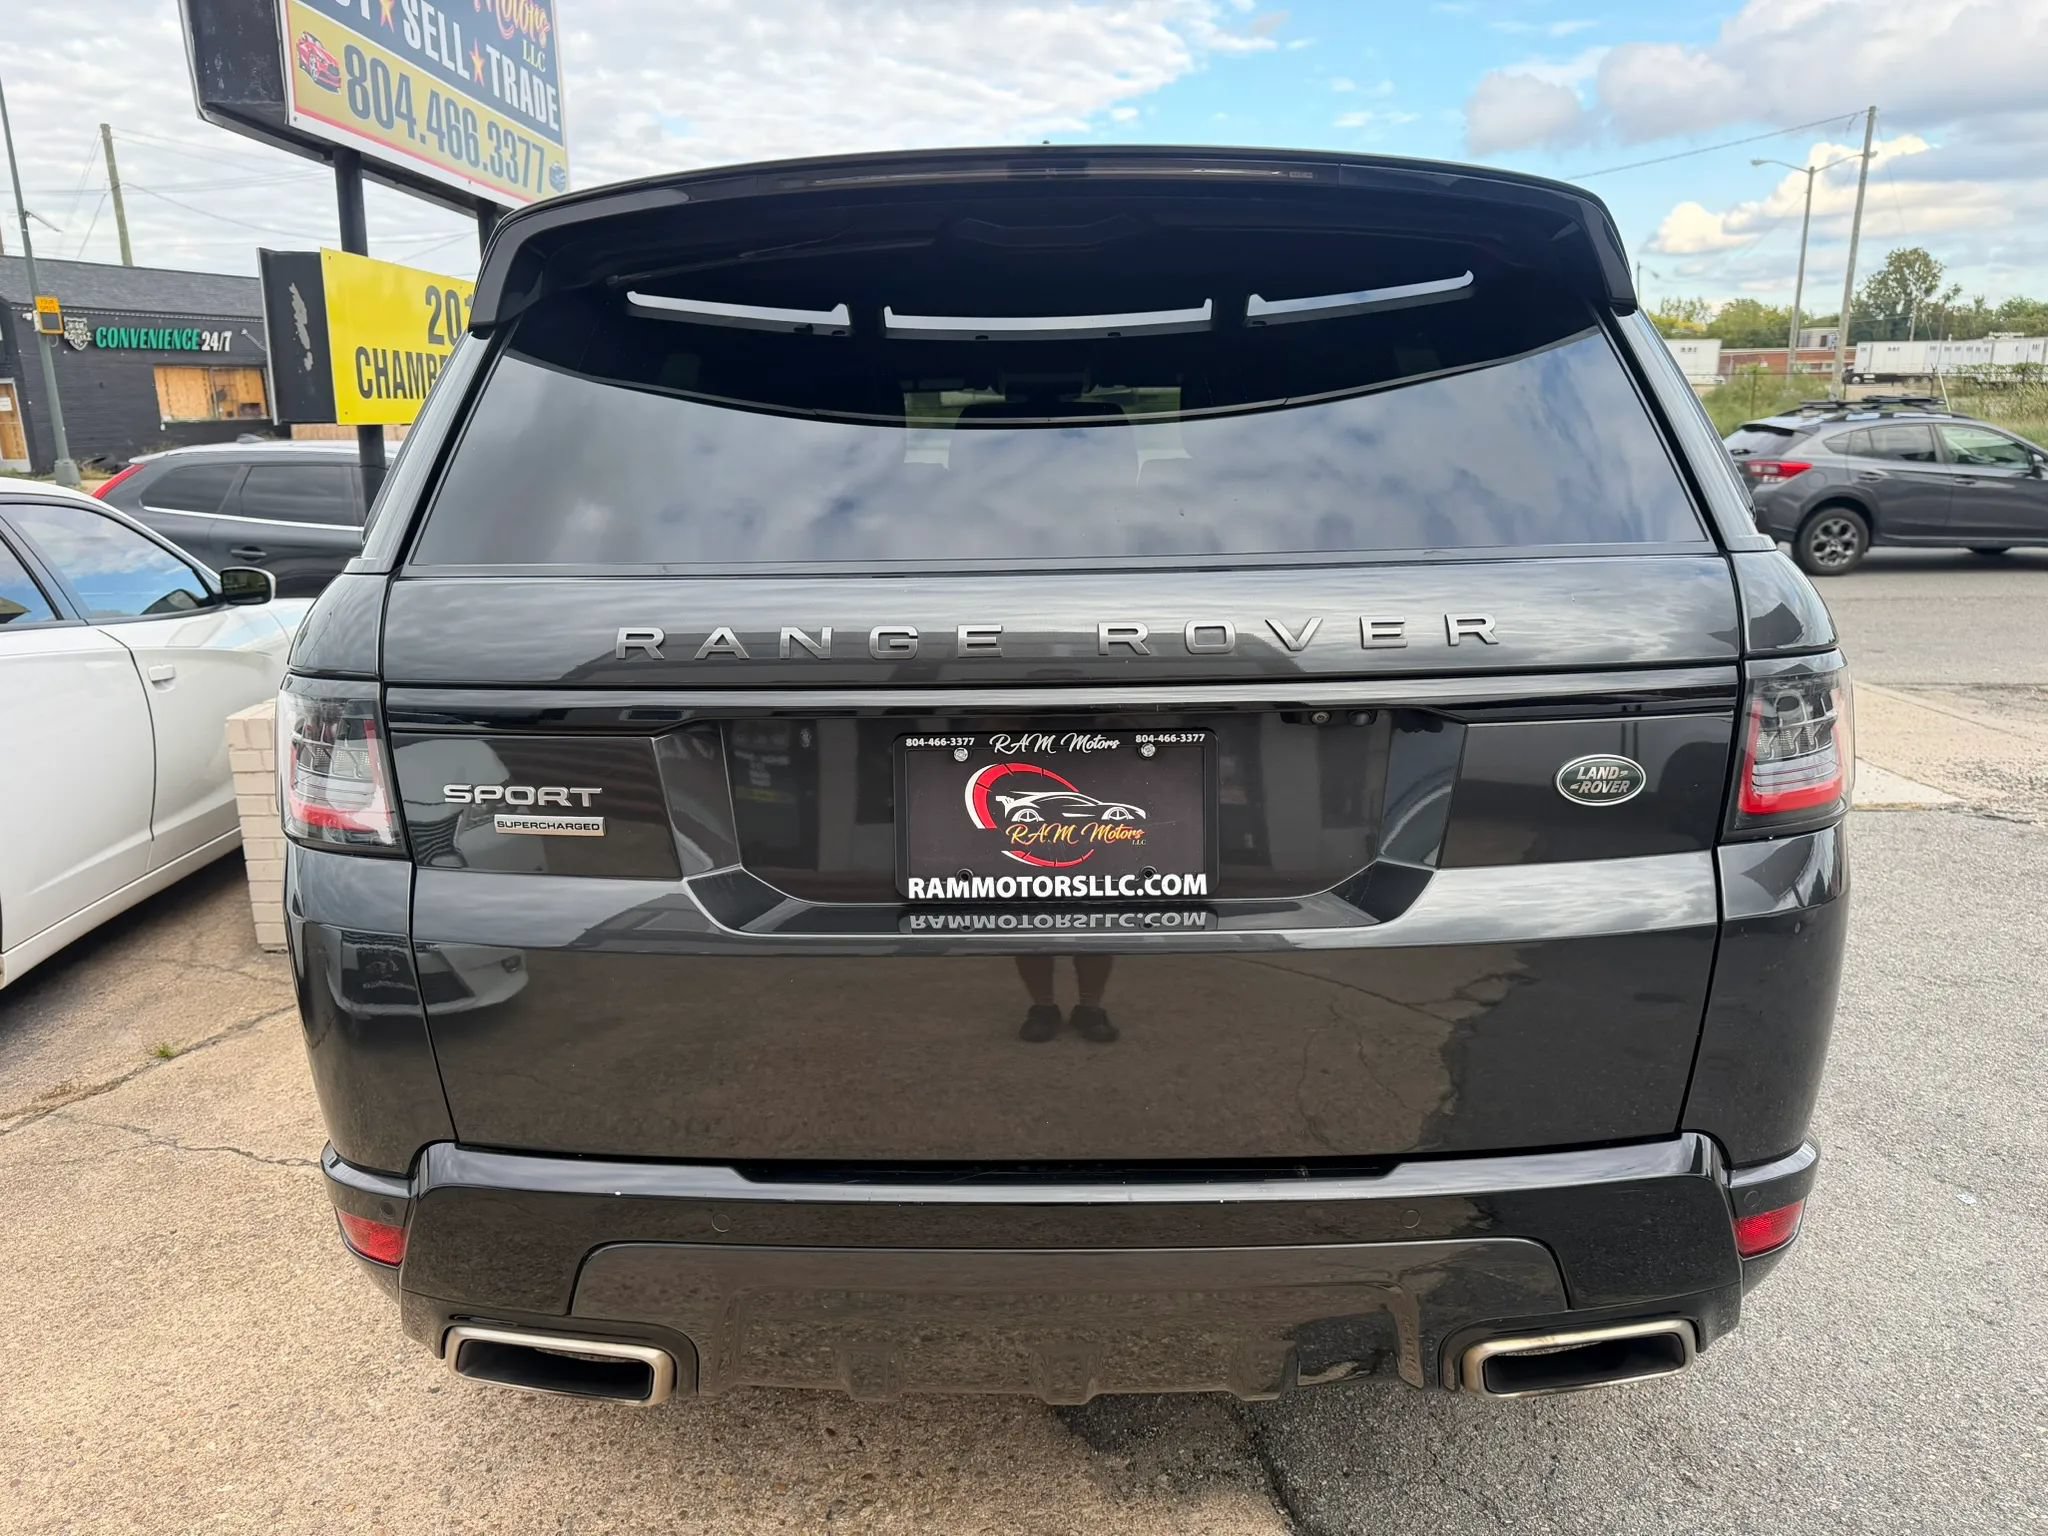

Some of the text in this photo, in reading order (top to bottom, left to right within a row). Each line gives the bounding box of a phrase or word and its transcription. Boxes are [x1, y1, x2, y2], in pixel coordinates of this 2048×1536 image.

[401, 0, 560, 131] SELL TRADE
[522, 39, 547, 73] LLC
[344, 44, 545, 194] 804.466.3377
[425, 285, 474, 346] 20
[95, 326, 200, 350] CONVENIENCE
[201, 330, 232, 352] 24/7
[355, 346, 449, 400] CHAMB
[616, 613, 1500, 660] RANGE ROVER
[905, 737, 975, 747] 804-466-3377
[989, 732, 1120, 755] RAM Motors
[1135, 733, 1206, 743] 804-466-3377
[1576, 766, 1619, 779] LAND
[443, 784, 602, 807] SPORT
[1578, 780, 1630, 793] ROVER
[496, 820, 600, 830] SUPERCHARGED
[1005, 822, 1145, 845] RAM Motors
[908, 874, 1208, 899] RAMMOTORSLLC.COM
